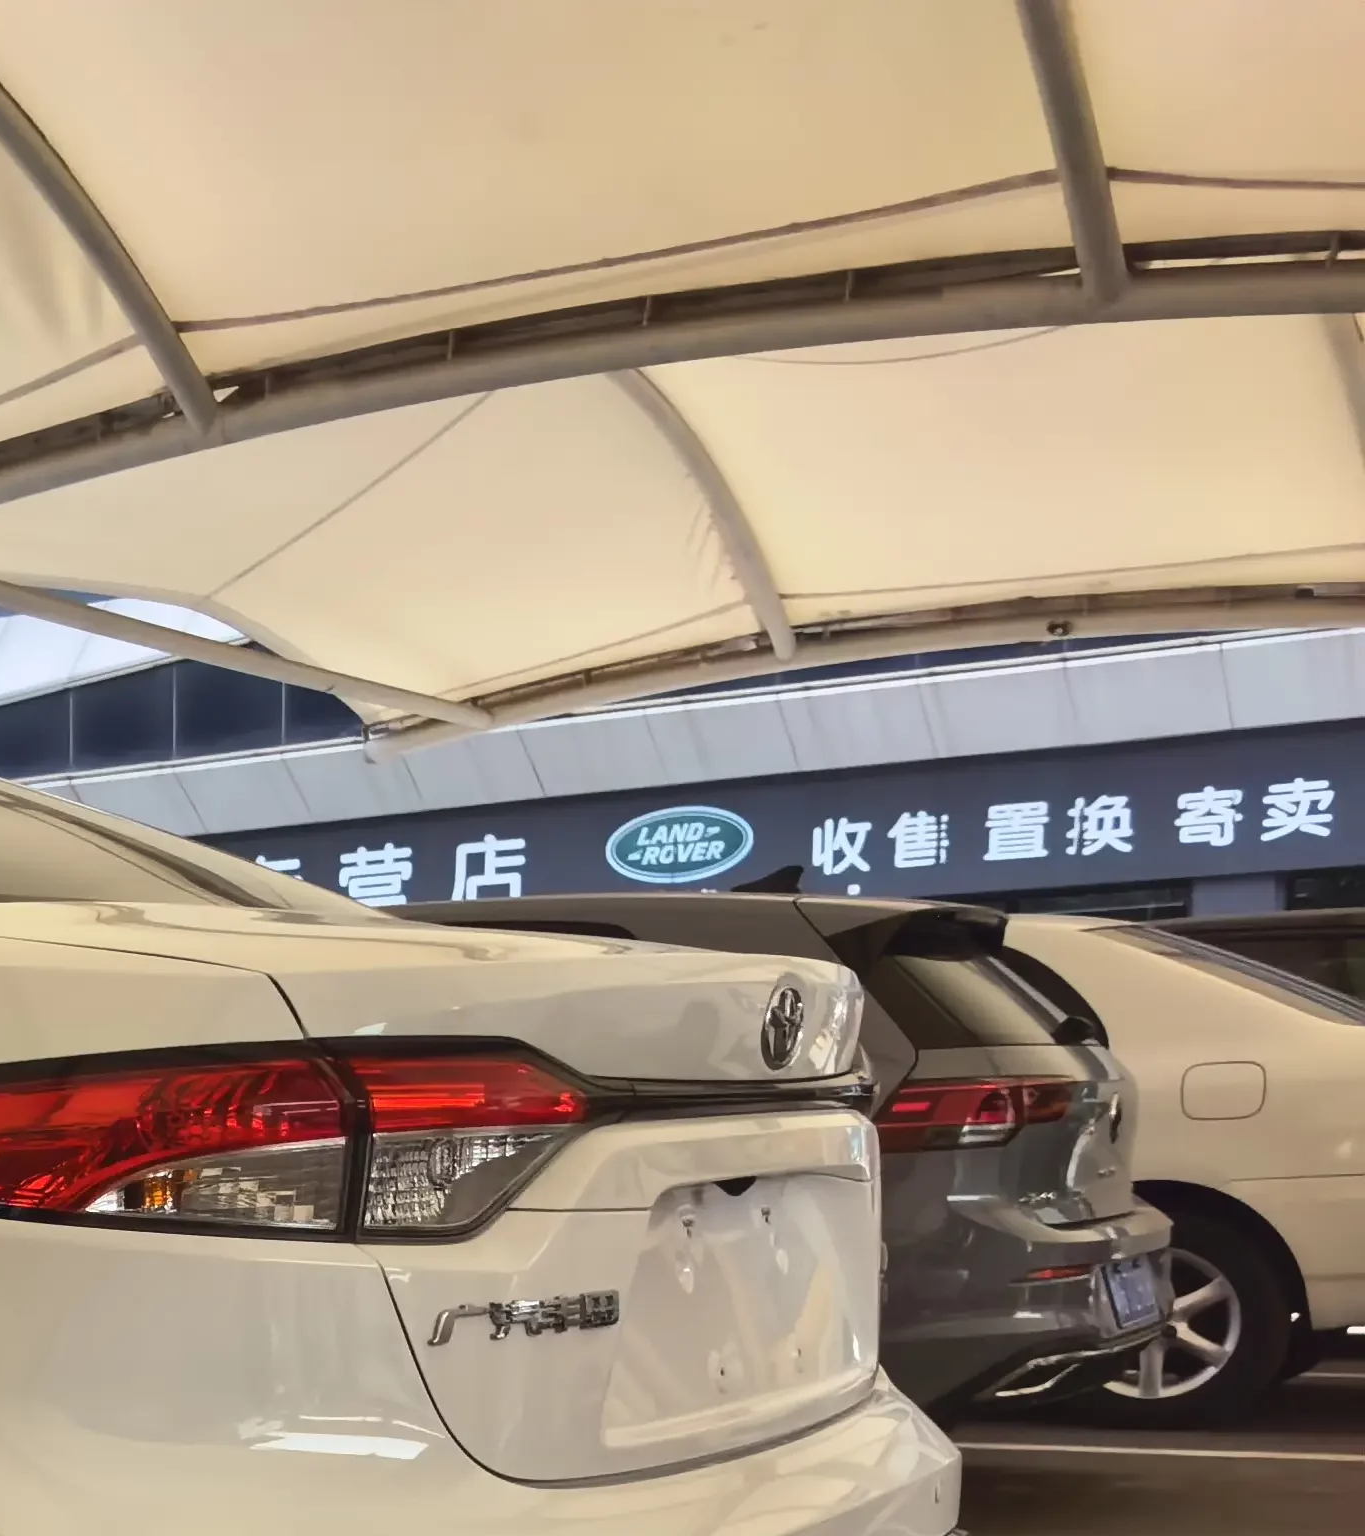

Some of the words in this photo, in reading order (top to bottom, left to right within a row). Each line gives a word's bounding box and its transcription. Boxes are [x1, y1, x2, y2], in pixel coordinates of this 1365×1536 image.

[983, 795, 1134, 861] 置换
[1174, 777, 1335, 846] 寄卖
[636, 821, 705, 847] LAND
[640, 841, 726, 867] ROVER
